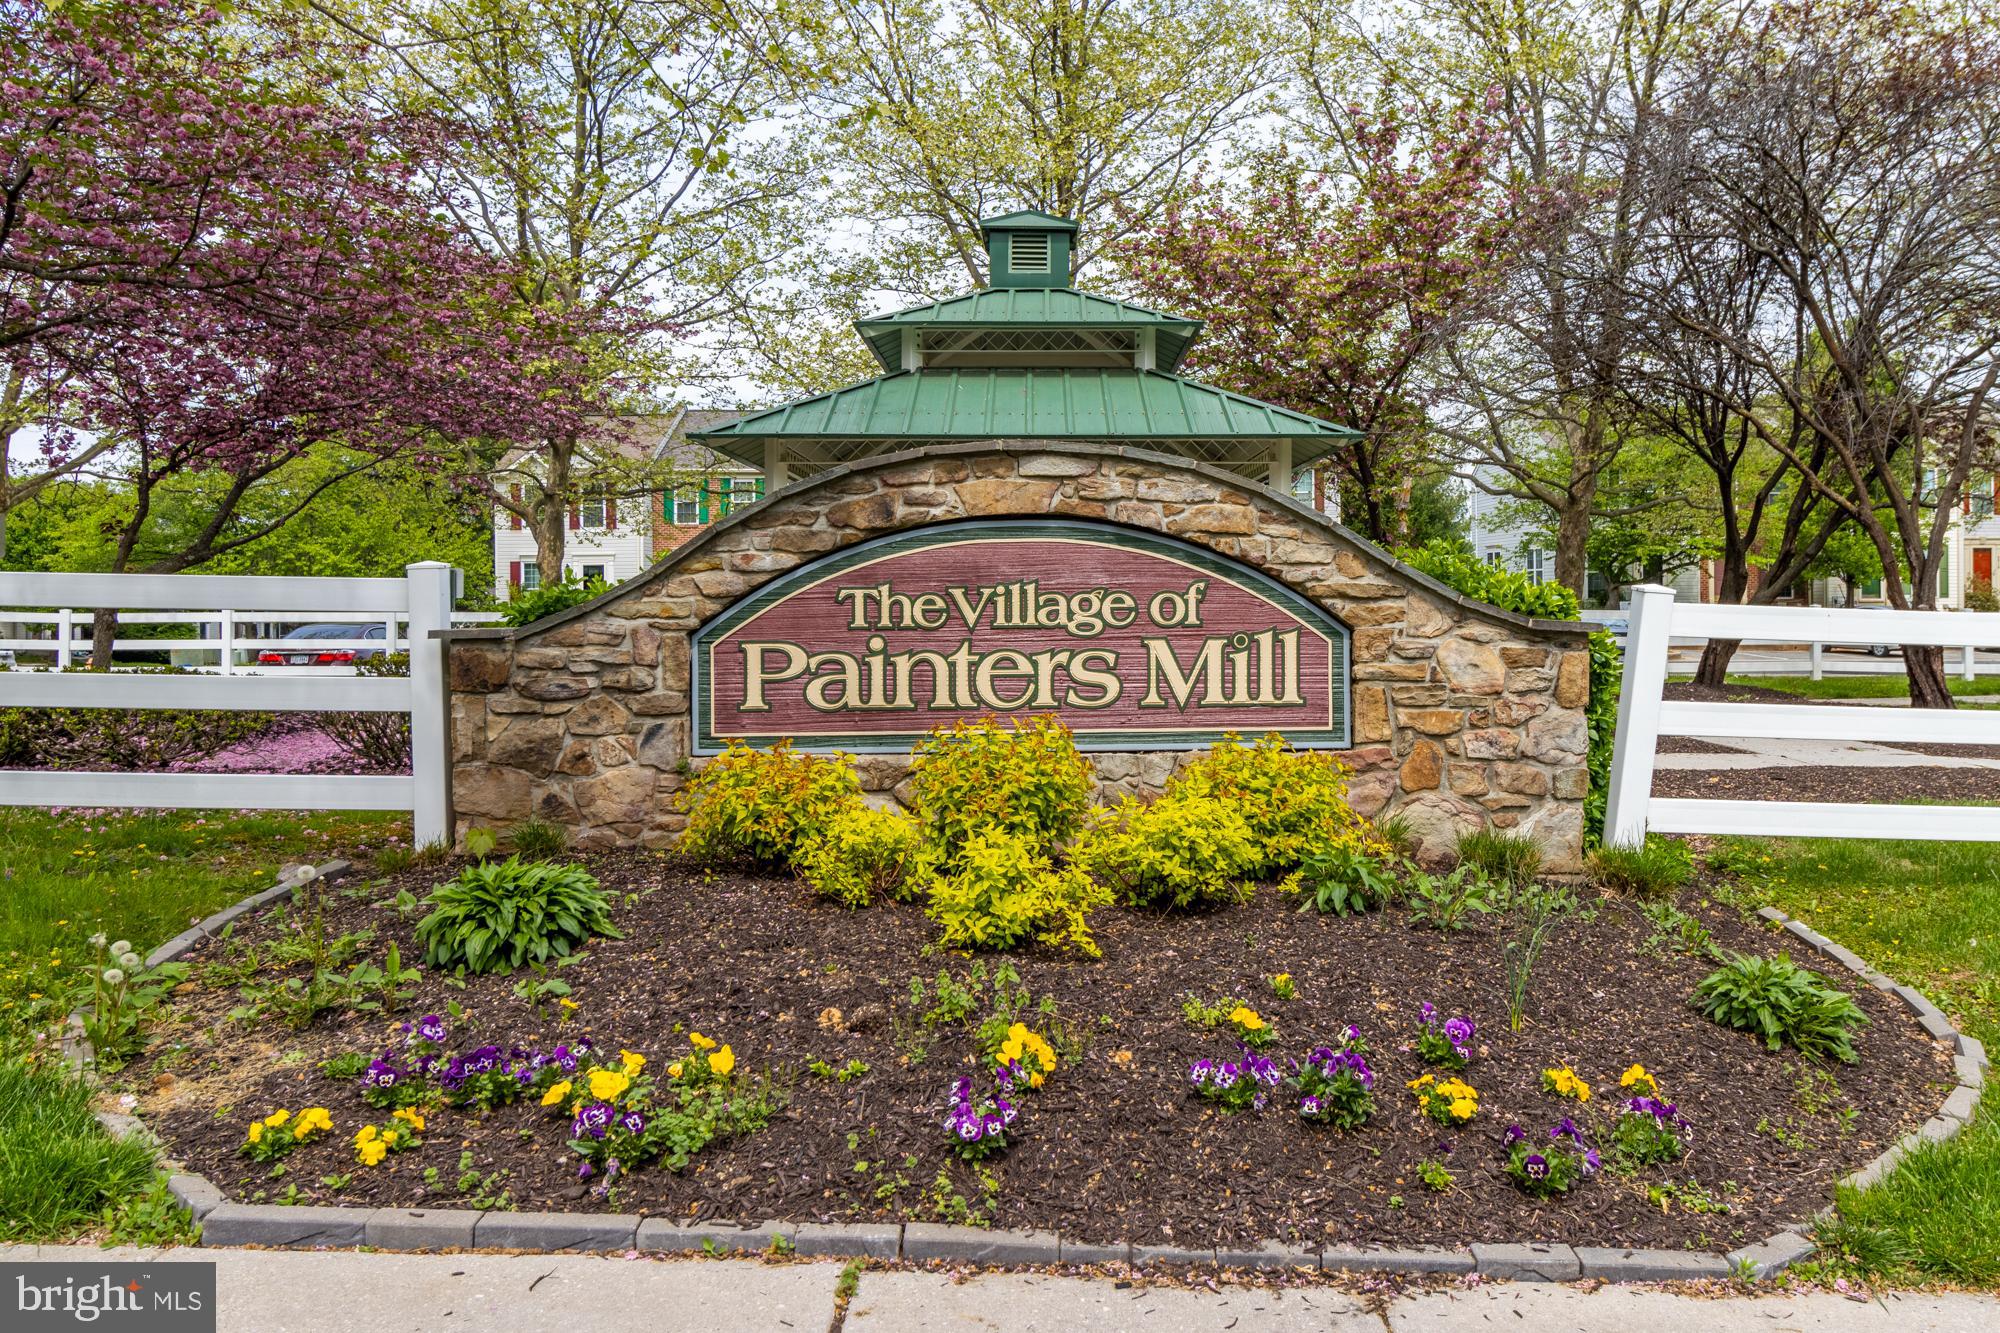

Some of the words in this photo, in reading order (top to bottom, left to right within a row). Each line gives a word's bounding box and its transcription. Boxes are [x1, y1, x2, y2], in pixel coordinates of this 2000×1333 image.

[837, 582, 949, 629] The
[947, 580, 1137, 636] Village
[1149, 580, 1208, 627] of
[738, 636, 1121, 711] Painters
[1139, 627, 1305, 711] Mill
